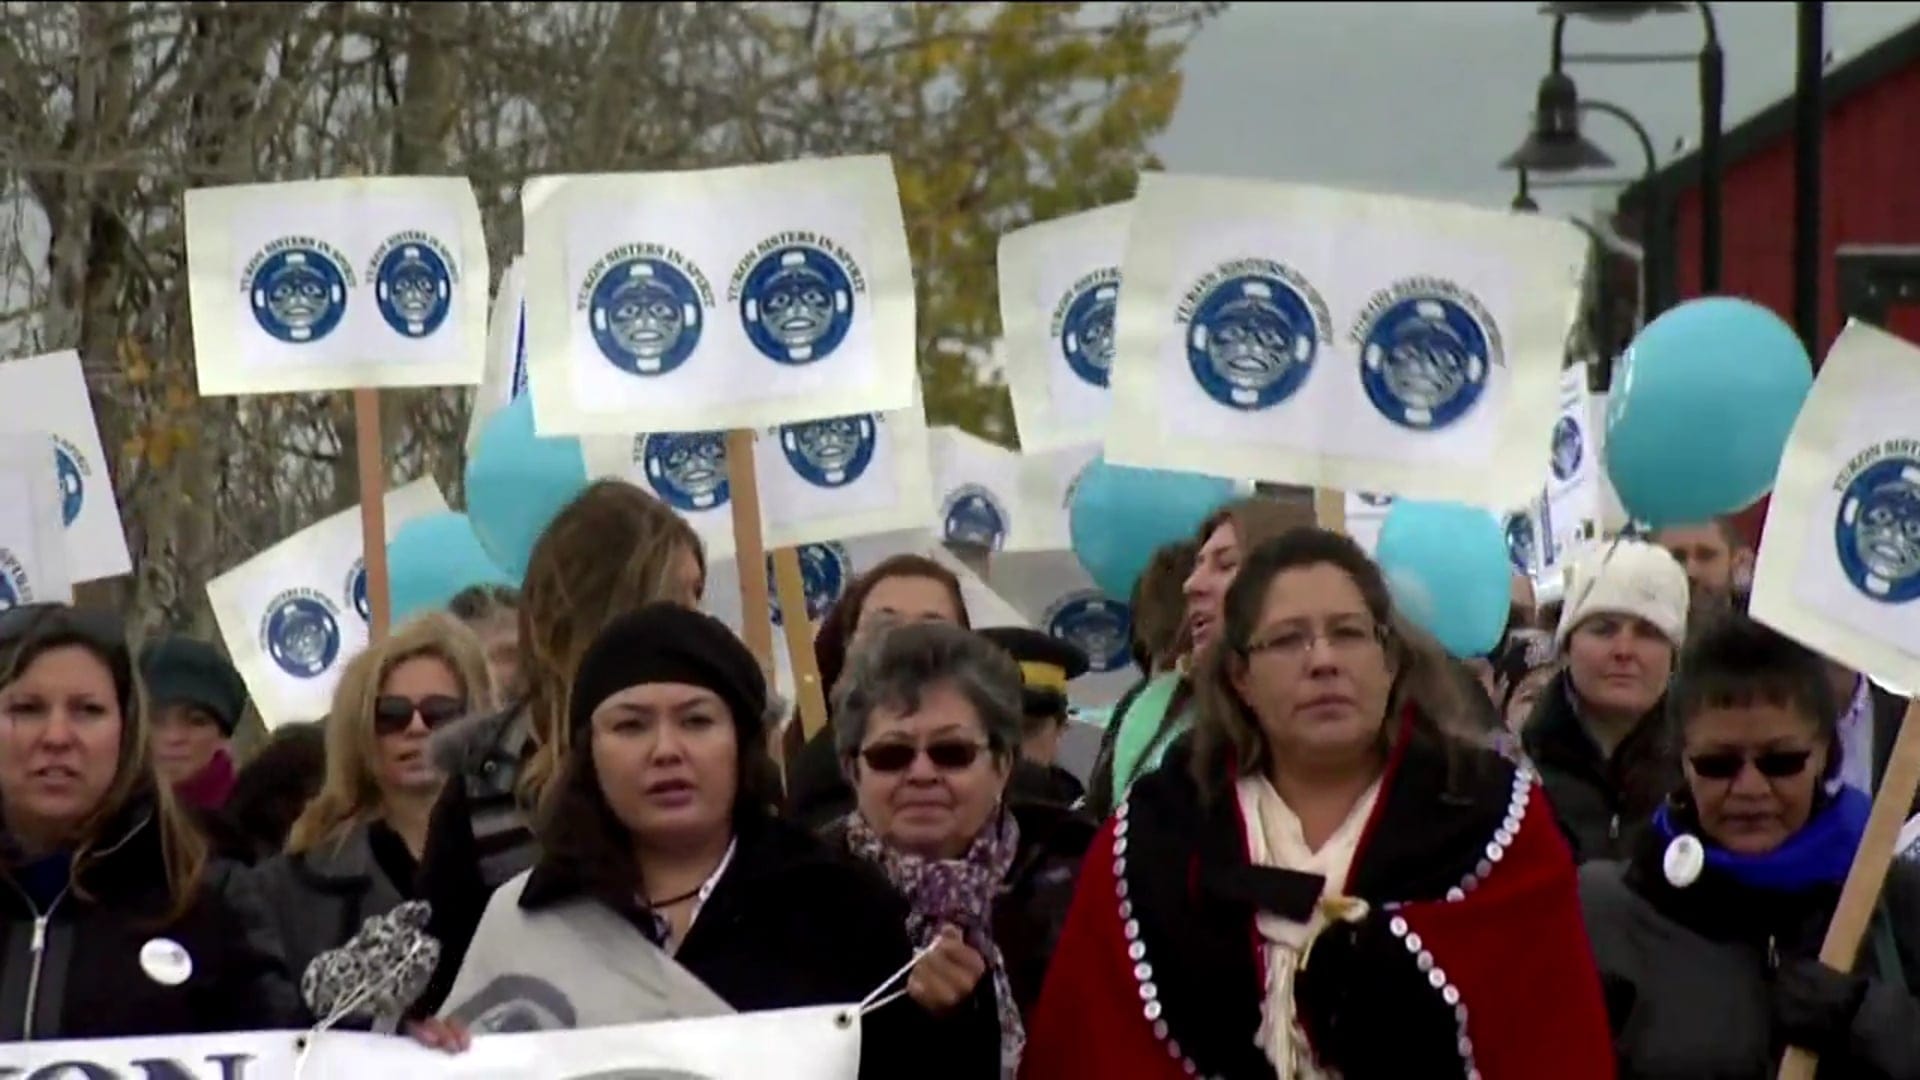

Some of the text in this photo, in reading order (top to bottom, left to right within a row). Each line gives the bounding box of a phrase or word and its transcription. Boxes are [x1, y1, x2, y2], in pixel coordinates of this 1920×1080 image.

[577, 243, 715, 311] YUKON SISTERS IN SPIRIT
[727, 231, 866, 302] YUKON SISTERS IN SPIRIT
[1832, 443, 1881, 492] YUKON
